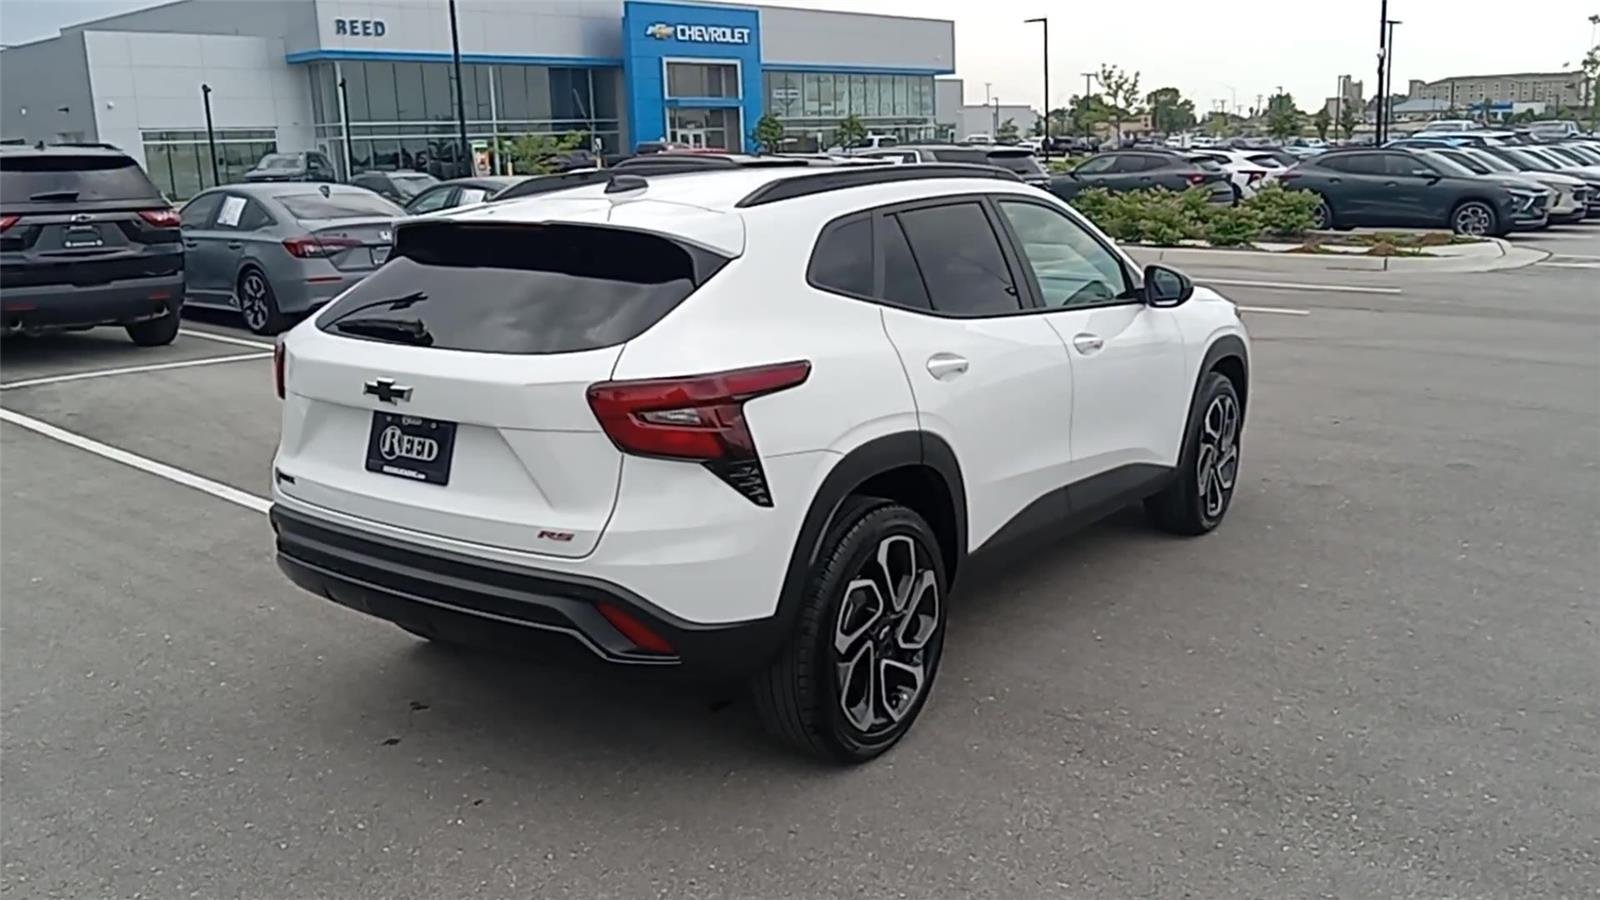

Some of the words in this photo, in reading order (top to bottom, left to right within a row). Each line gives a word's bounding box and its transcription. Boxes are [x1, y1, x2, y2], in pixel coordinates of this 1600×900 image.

[335, 19, 386, 37] REED
[676, 24, 750, 43] CHEVROLET
[380, 426, 439, 462] REED
[537, 530, 575, 541] RS
